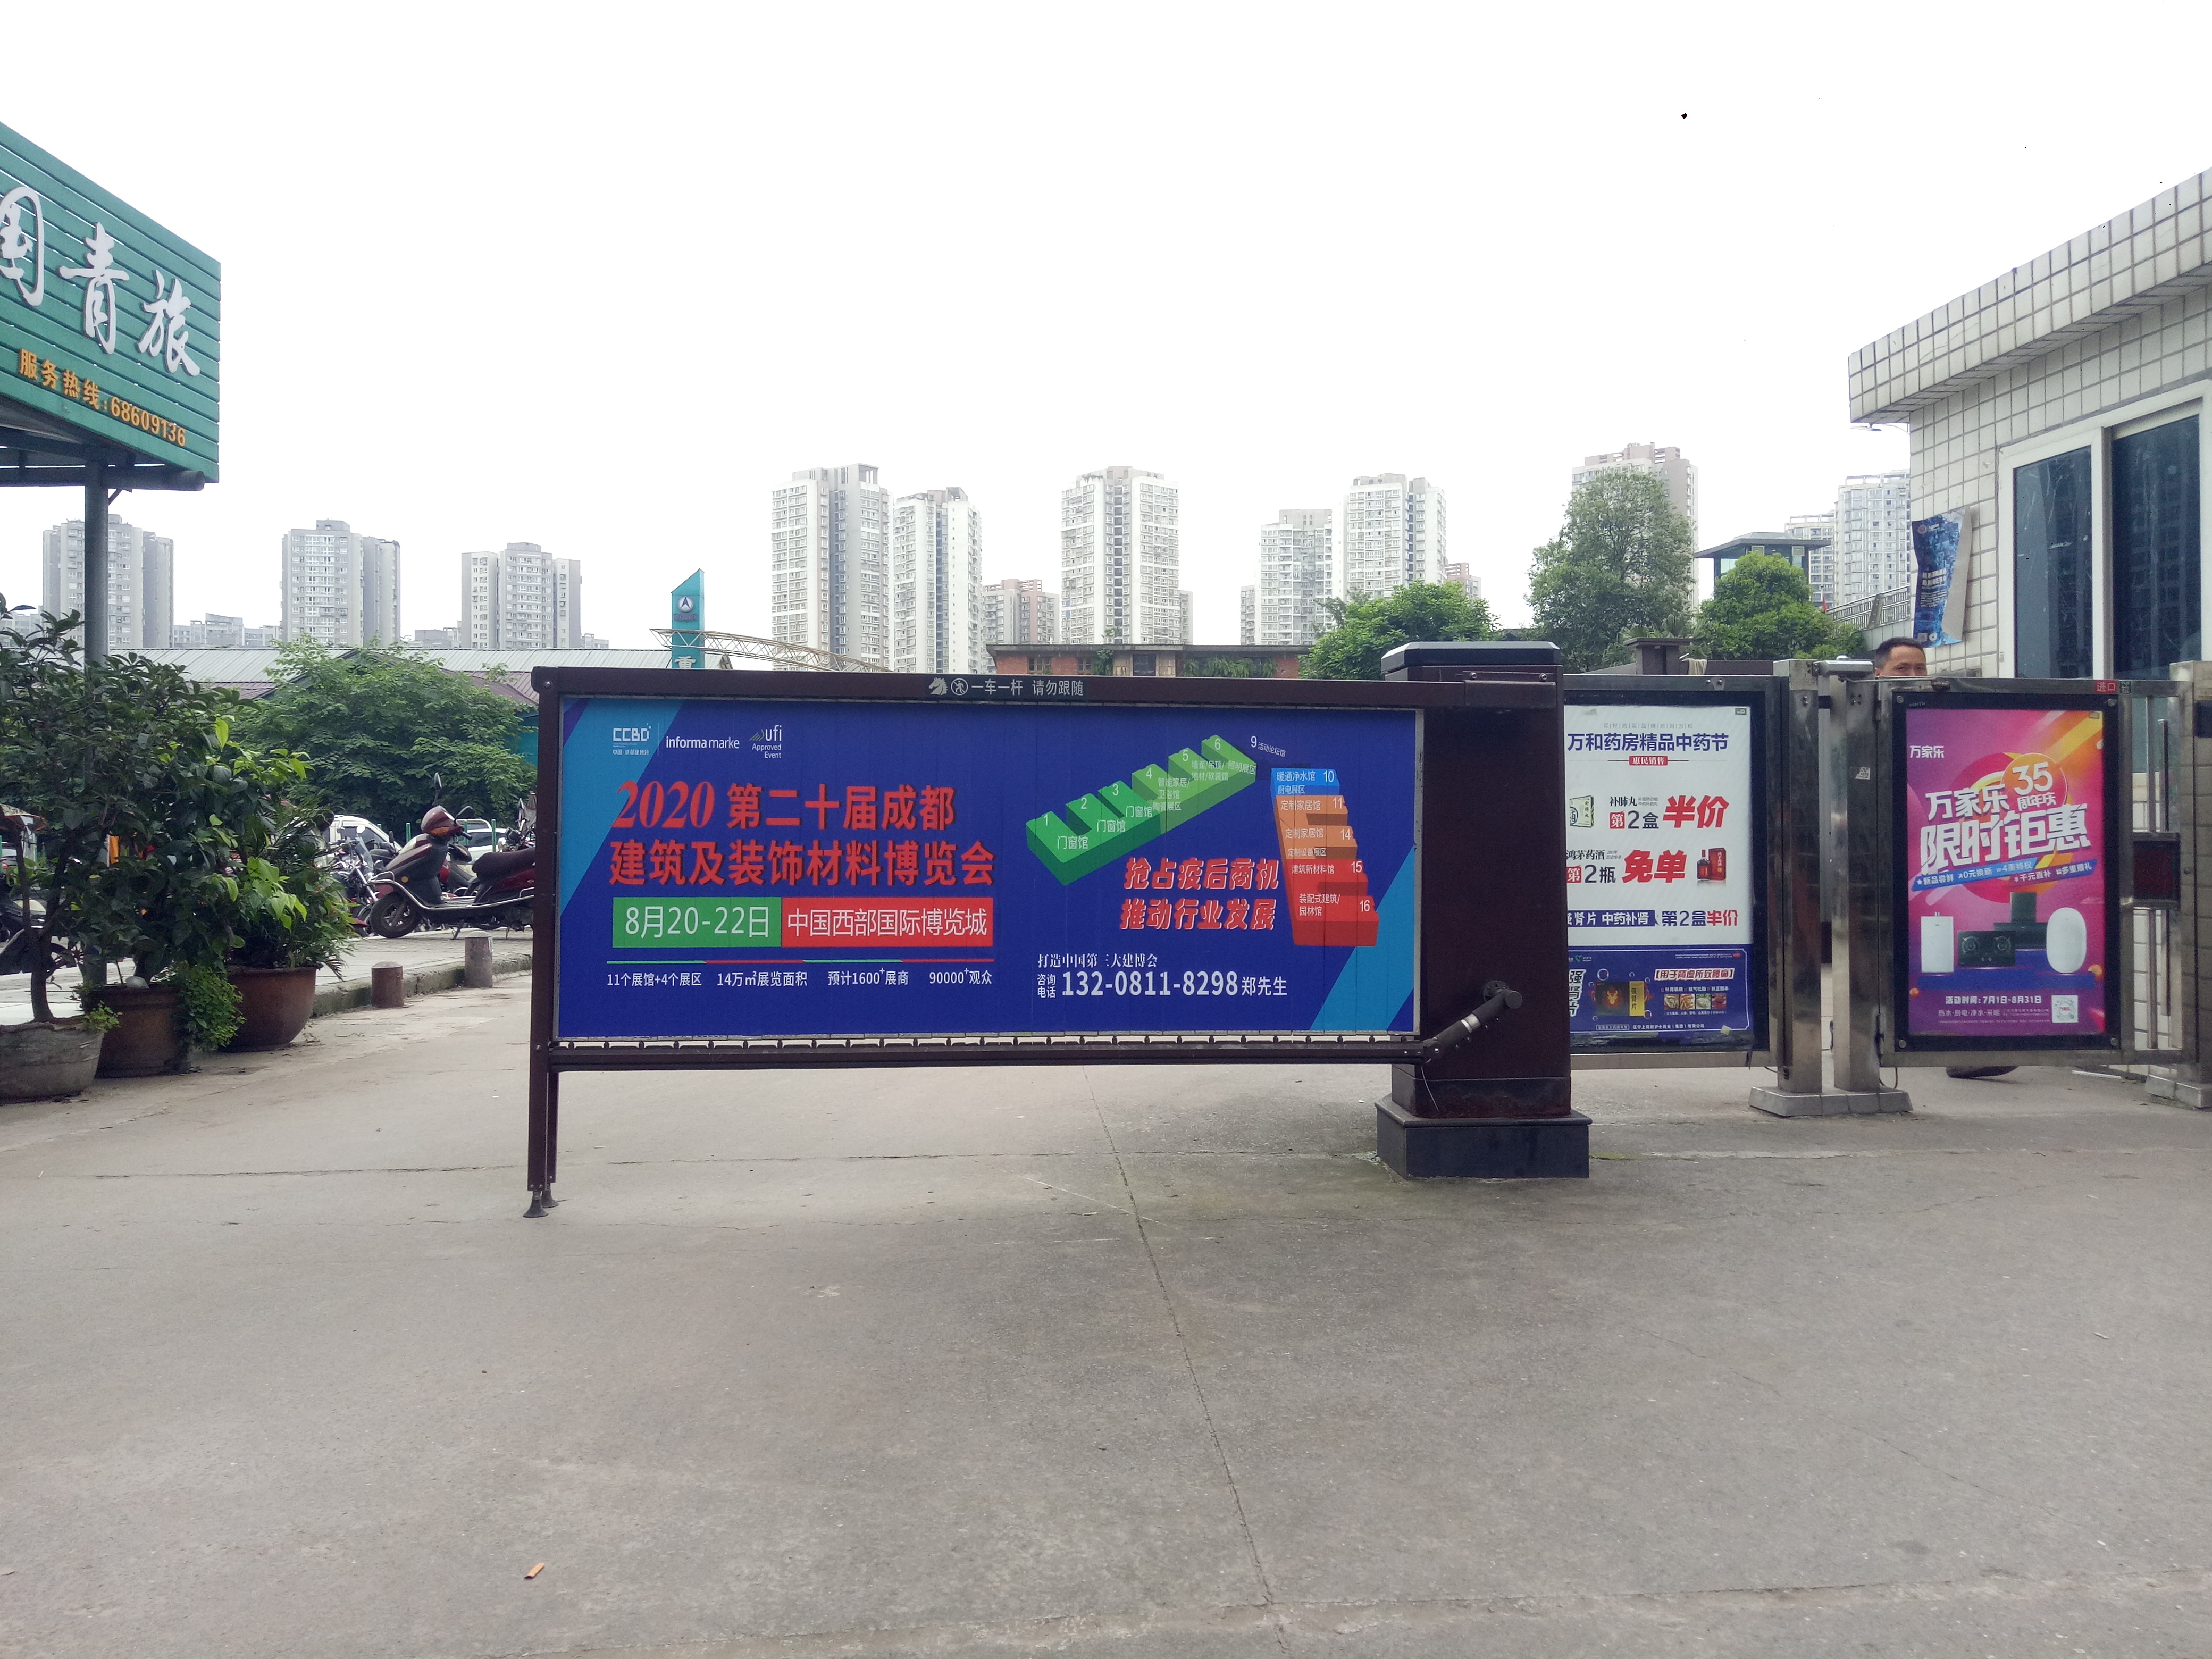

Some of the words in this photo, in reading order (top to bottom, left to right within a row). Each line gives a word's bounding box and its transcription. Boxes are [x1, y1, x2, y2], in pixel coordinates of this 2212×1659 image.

[19, 348, 186, 448] 服务热线:68609136
[971, 678, 1023, 695] 一车一杆
[1032, 680, 1084, 696] 请勿跟随
[2097, 682, 2116, 692] 进口
[765, 725, 782, 742] ufi
[666, 736, 707, 748] informa
[709, 737, 740, 749] marke
[1214, 739, 1221, 750] 6
[1251, 736, 1257, 748] 9
[1568, 733, 1729, 752] 万和药房精品中药节
[1183, 750, 1189, 761] 5
[1909, 745, 1945, 758] 万家乐
[1146, 767, 1152, 778] 4
[1228, 760, 1256, 775] 照明展区
[1158, 777, 1191, 788] 智能家居/
[1277, 771, 1316, 781] 暖通净水馆
[1323, 770, 1334, 782] 10
[2012, 762, 2053, 795] 35
[1112, 784, 1119, 795] 3
[1158, 790, 1180, 799] 卫浴馆
[1278, 785, 1305, 794] 厨电展区
[611, 781, 715, 828] 2020
[726, 783, 956, 831] 第二十届成都
[1080, 798, 1087, 809] 2
[1280, 800, 1321, 810] 定制家居馆
[1333, 797, 1343, 809] 11
[1609, 796, 1637, 807] 补肺丸
[1925, 784, 2010, 820] 万家乐
[2017, 792, 2056, 811] 周年庆
[1125, 806, 1153, 818] 门窗馆
[1610, 810, 1659, 829] 第2盒
[1663, 795, 1730, 828] 半价
[1044, 814, 1048, 826] 1
[1096, 820, 1126, 833] 门窗馆
[1285, 828, 1324, 839] 定制家居馆
[1340, 828, 1351, 840] 14
[1921, 803, 2091, 875] 限时钜惠
[1057, 836, 1089, 849] 门窗馆
[1288, 848, 1327, 857] 定制设备展区
[609, 839, 994, 886] 建筑及装饰材料博览会
[1292, 864, 1335, 874] 建筑新材料馆
[1351, 860, 1362, 873] 15
[1567, 865, 1616, 883] 第2瓶
[1622, 850, 1687, 883] 免单
[1124, 857, 1279, 890] 抢占疫后商机
[1299, 893, 1340, 904] 装配式建筑/
[1360, 900, 1370, 912] 16
[1120, 898, 1277, 930] 推动行业发展
[1299, 906, 1322, 916] 园林馆
[625, 906, 769, 939] 8月20-22日
[787, 908, 987, 937] 中国西部国际博览城
[1602, 911, 1649, 925] 中药补肾
[607, 973, 702, 987] 11个展馆+4个展区
[828, 967, 909, 986] 预计1600+展商
[929, 967, 993, 985] 90000+观众
[1037, 974, 1056, 985] 咨询
[1062, 971, 1238, 996] 132-0811-8298
[1241, 977, 1287, 996] 郑先生
[1037, 986, 1056, 998] 电话
